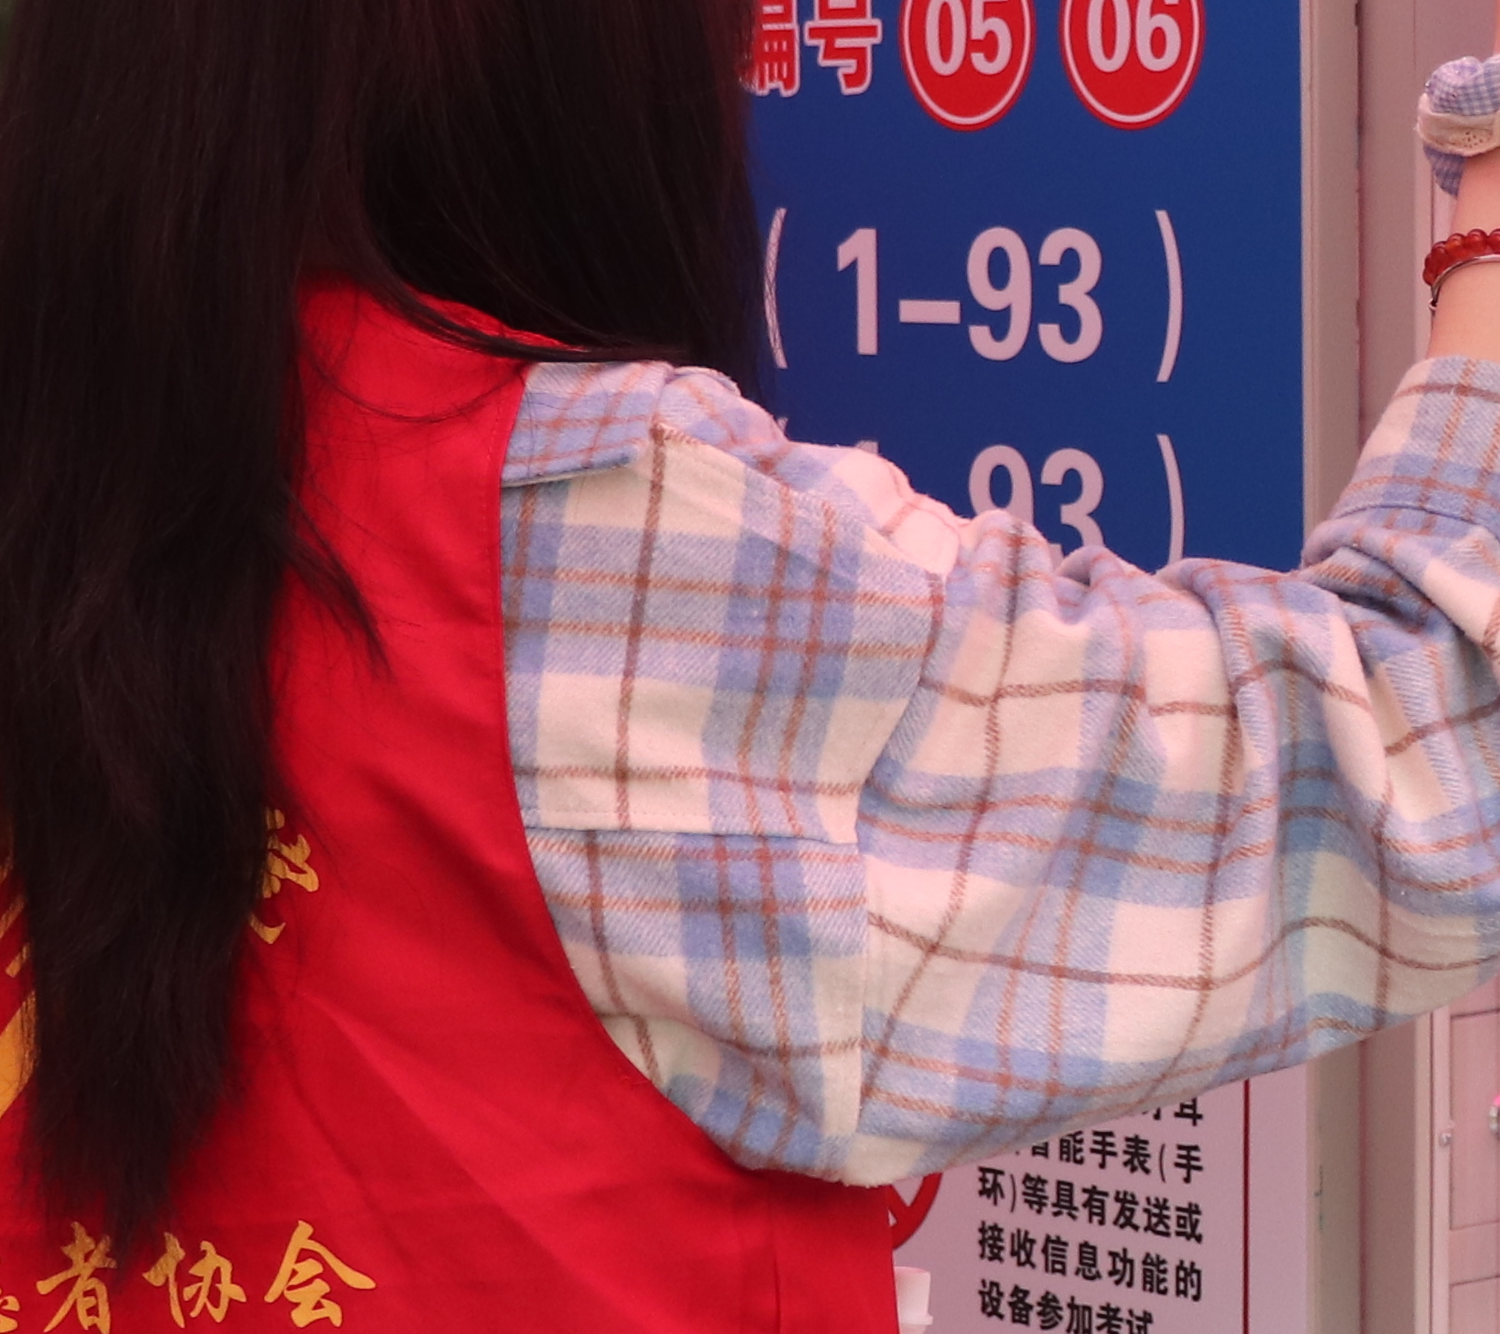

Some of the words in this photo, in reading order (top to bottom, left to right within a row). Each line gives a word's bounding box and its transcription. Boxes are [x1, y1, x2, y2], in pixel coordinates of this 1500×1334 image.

[977, 1221, 1203, 1302] 接收信息功能的
